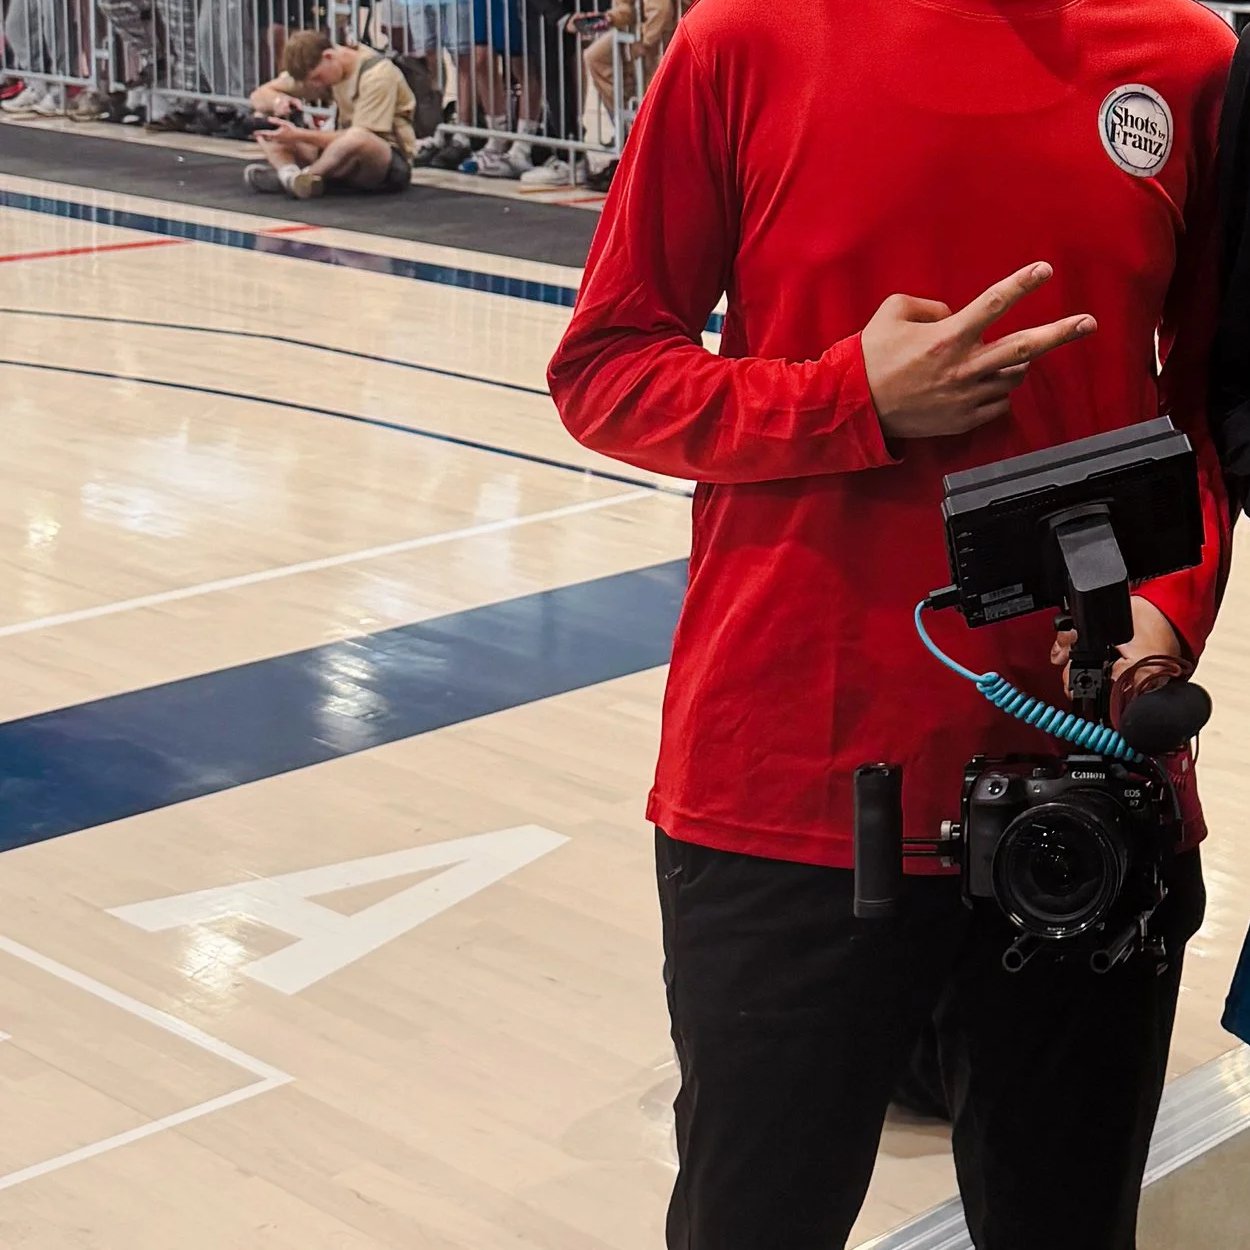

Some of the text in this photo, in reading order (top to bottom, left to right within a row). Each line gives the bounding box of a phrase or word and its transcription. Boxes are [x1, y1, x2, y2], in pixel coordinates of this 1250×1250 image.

[1110, 119, 1164, 158] Franz
[1112, 106, 1166, 140] Shots by
[1071, 771, 1106, 780] Canon
[1124, 789, 1141, 798] EOS
[104, 823, 572, 996] A
